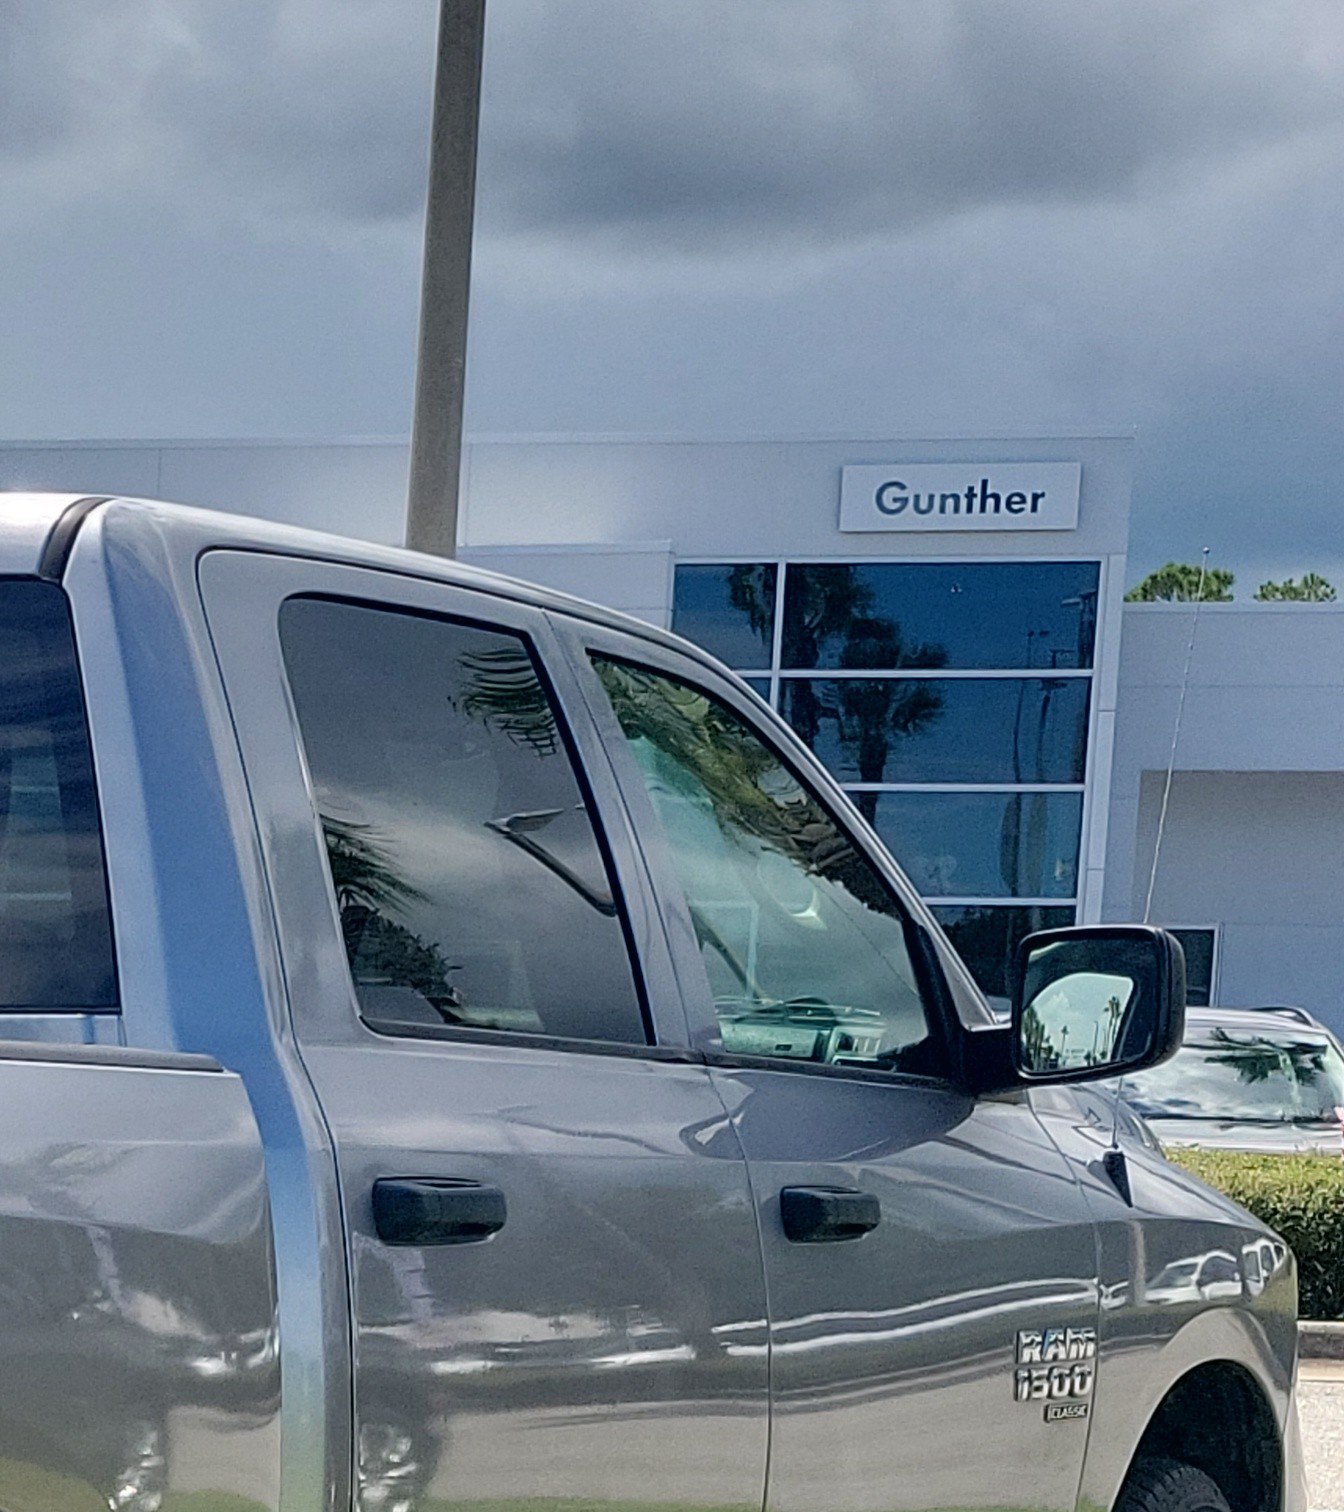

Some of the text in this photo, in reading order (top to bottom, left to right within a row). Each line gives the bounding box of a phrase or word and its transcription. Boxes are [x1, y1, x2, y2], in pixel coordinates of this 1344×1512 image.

[874, 478, 1046, 515] Gunther
[1016, 1327, 1097, 1364] RAM
[1014, 1363, 1092, 1401] 1500
